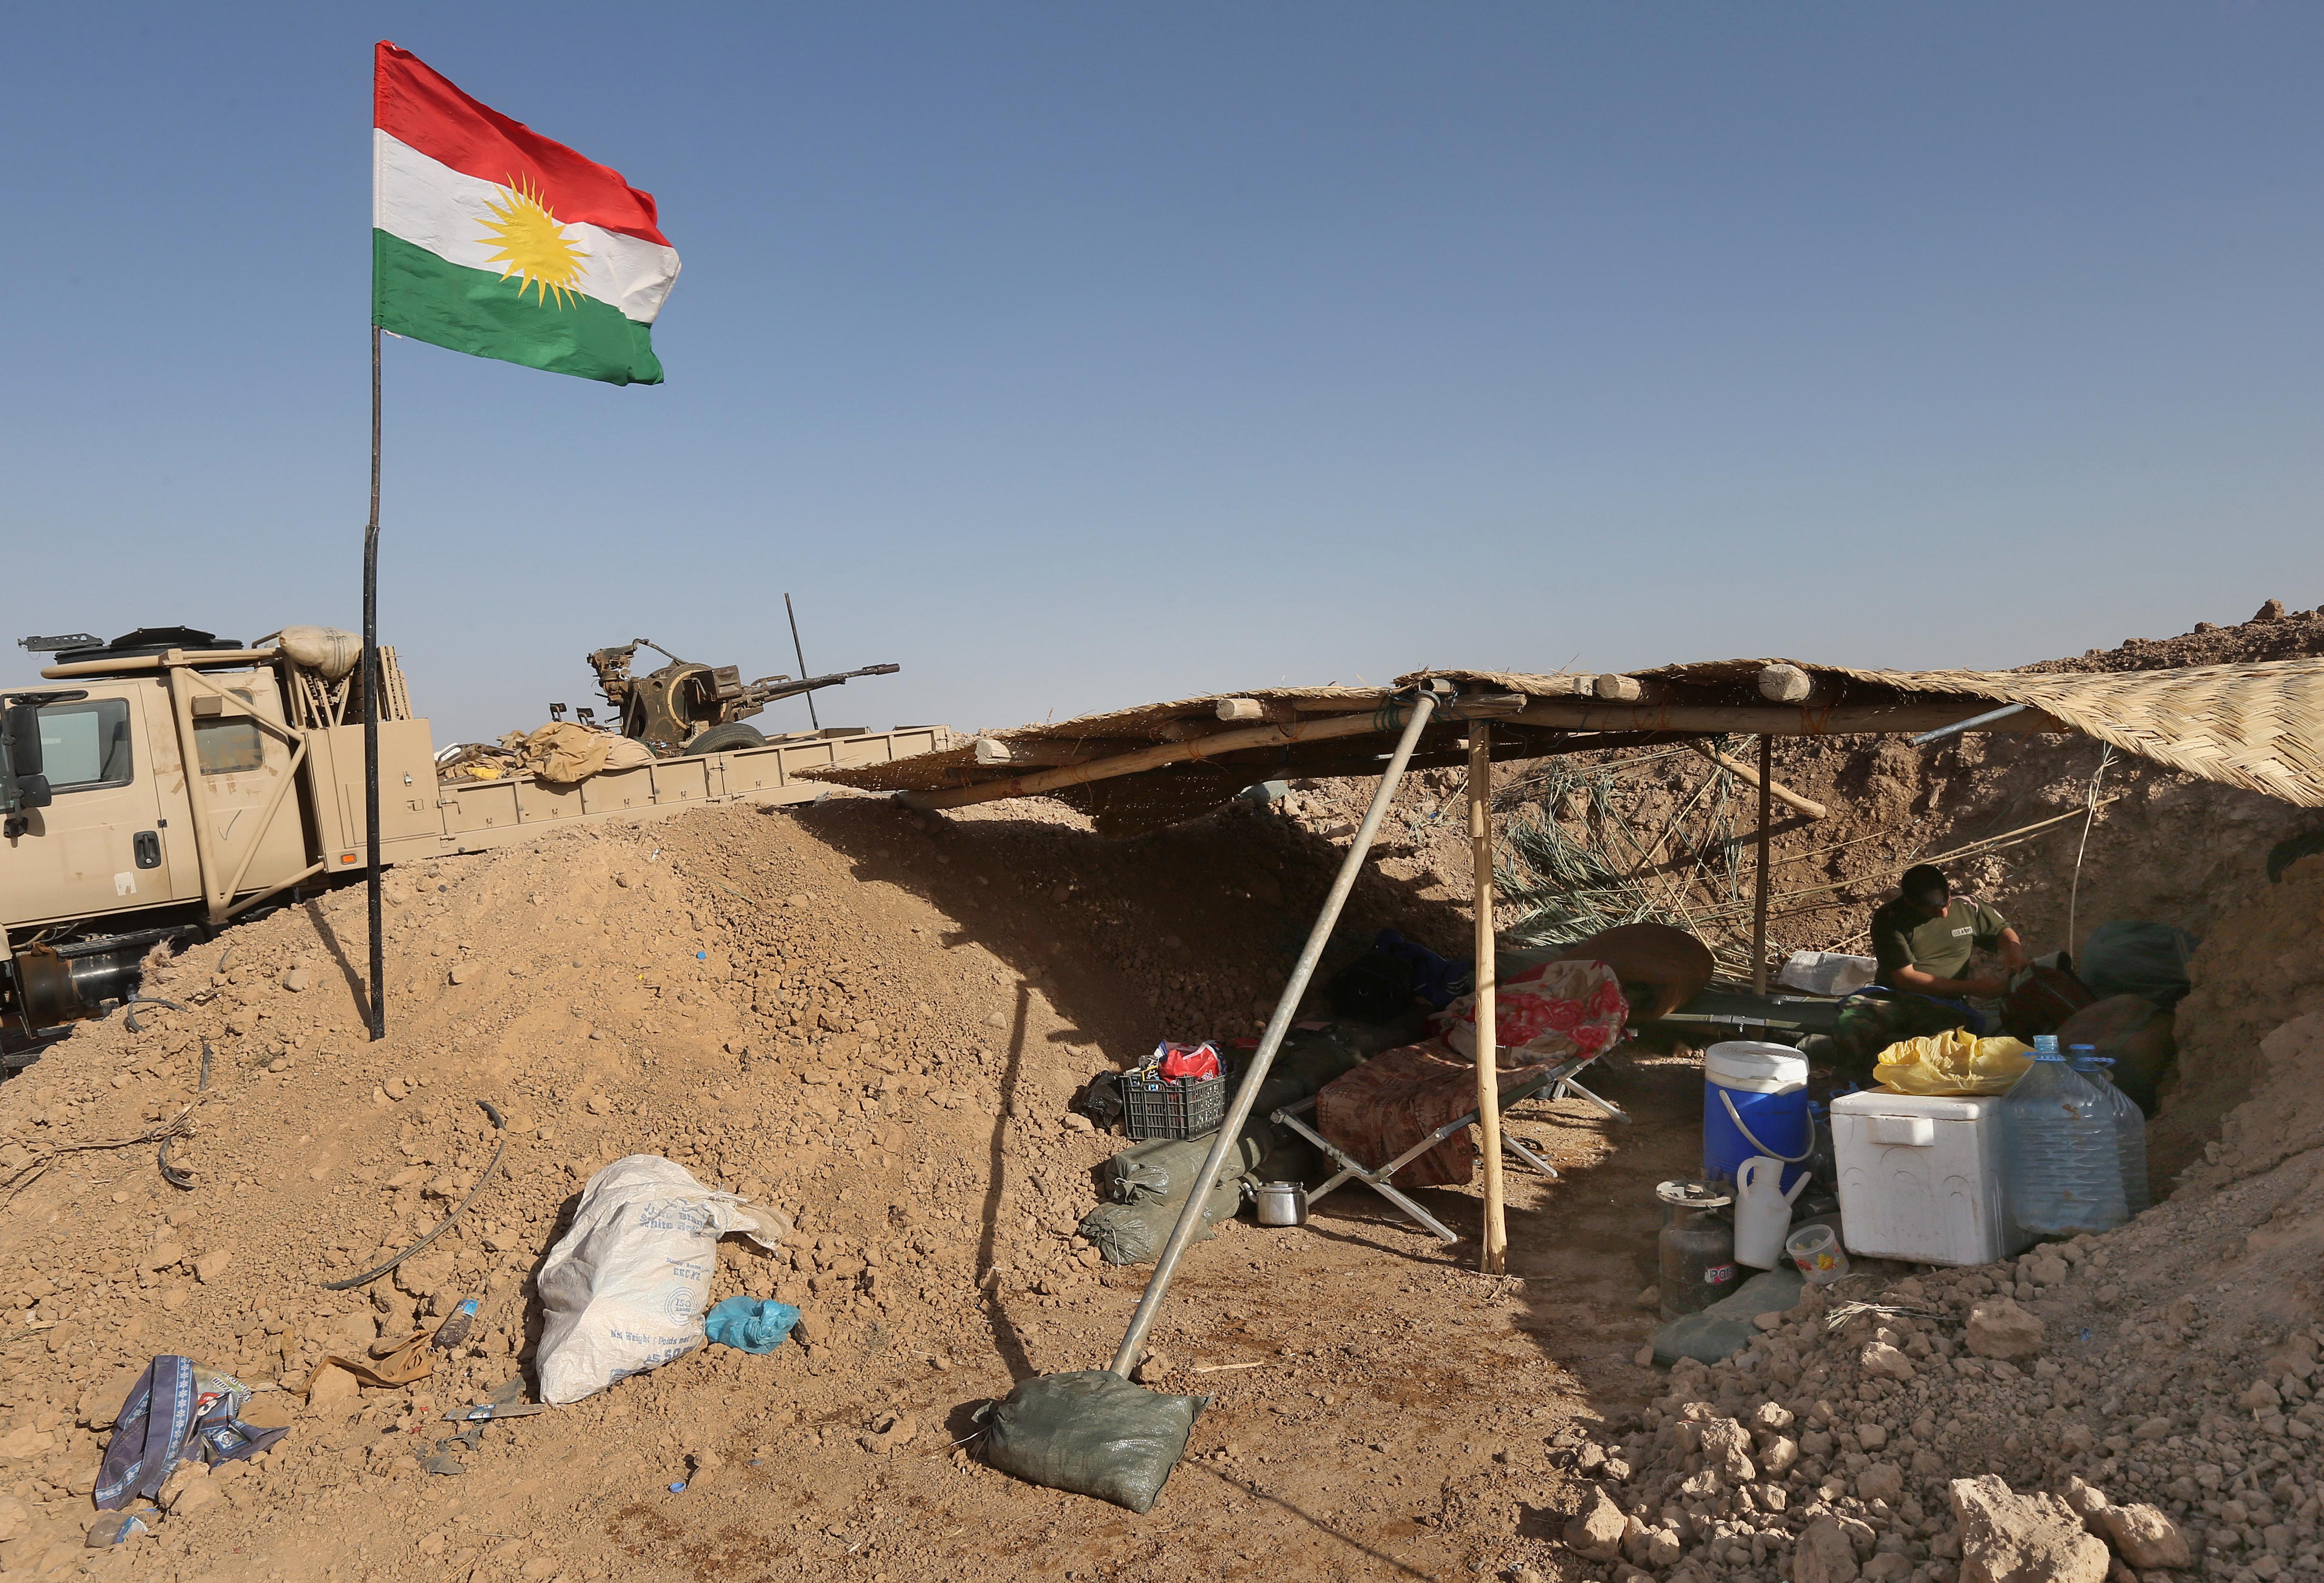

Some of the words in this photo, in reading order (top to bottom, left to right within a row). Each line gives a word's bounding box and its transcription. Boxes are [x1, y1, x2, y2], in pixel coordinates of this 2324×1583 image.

[675, 1298, 692, 1307] ISO
[625, 1331, 650, 1345] Weight
[658, 1336, 677, 1345] Poids
